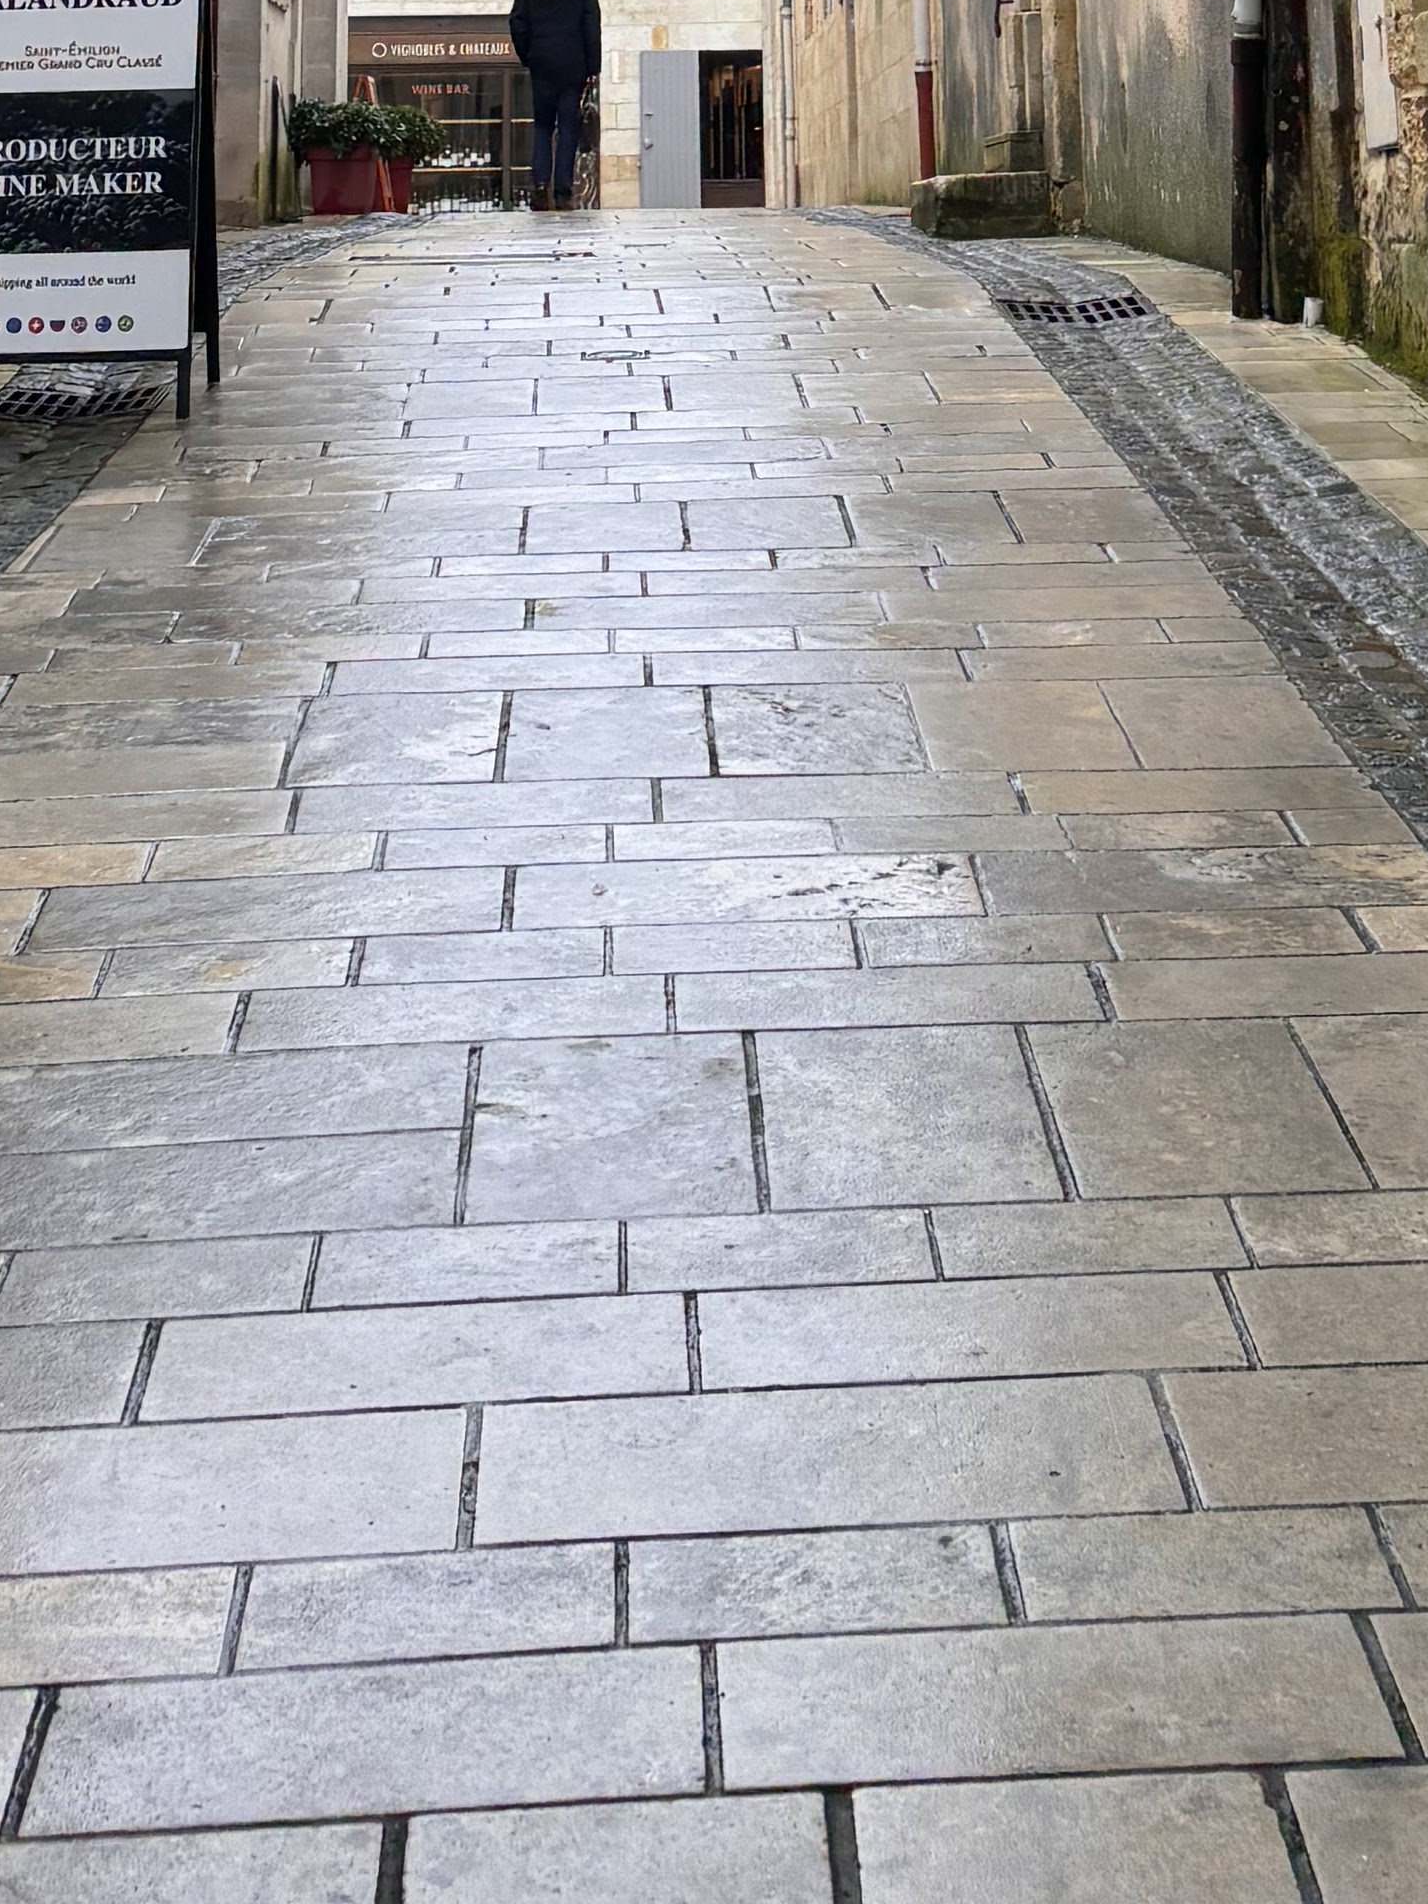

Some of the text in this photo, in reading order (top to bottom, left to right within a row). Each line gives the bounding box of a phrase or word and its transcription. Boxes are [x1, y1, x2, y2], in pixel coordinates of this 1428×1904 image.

[390, 42, 445, 57] VIGNOBLES
[449, 44, 456, 56] &
[411, 83, 471, 95] WINE BAR
[54, 170, 165, 196] MAKER
[35, 276, 48, 287] all
